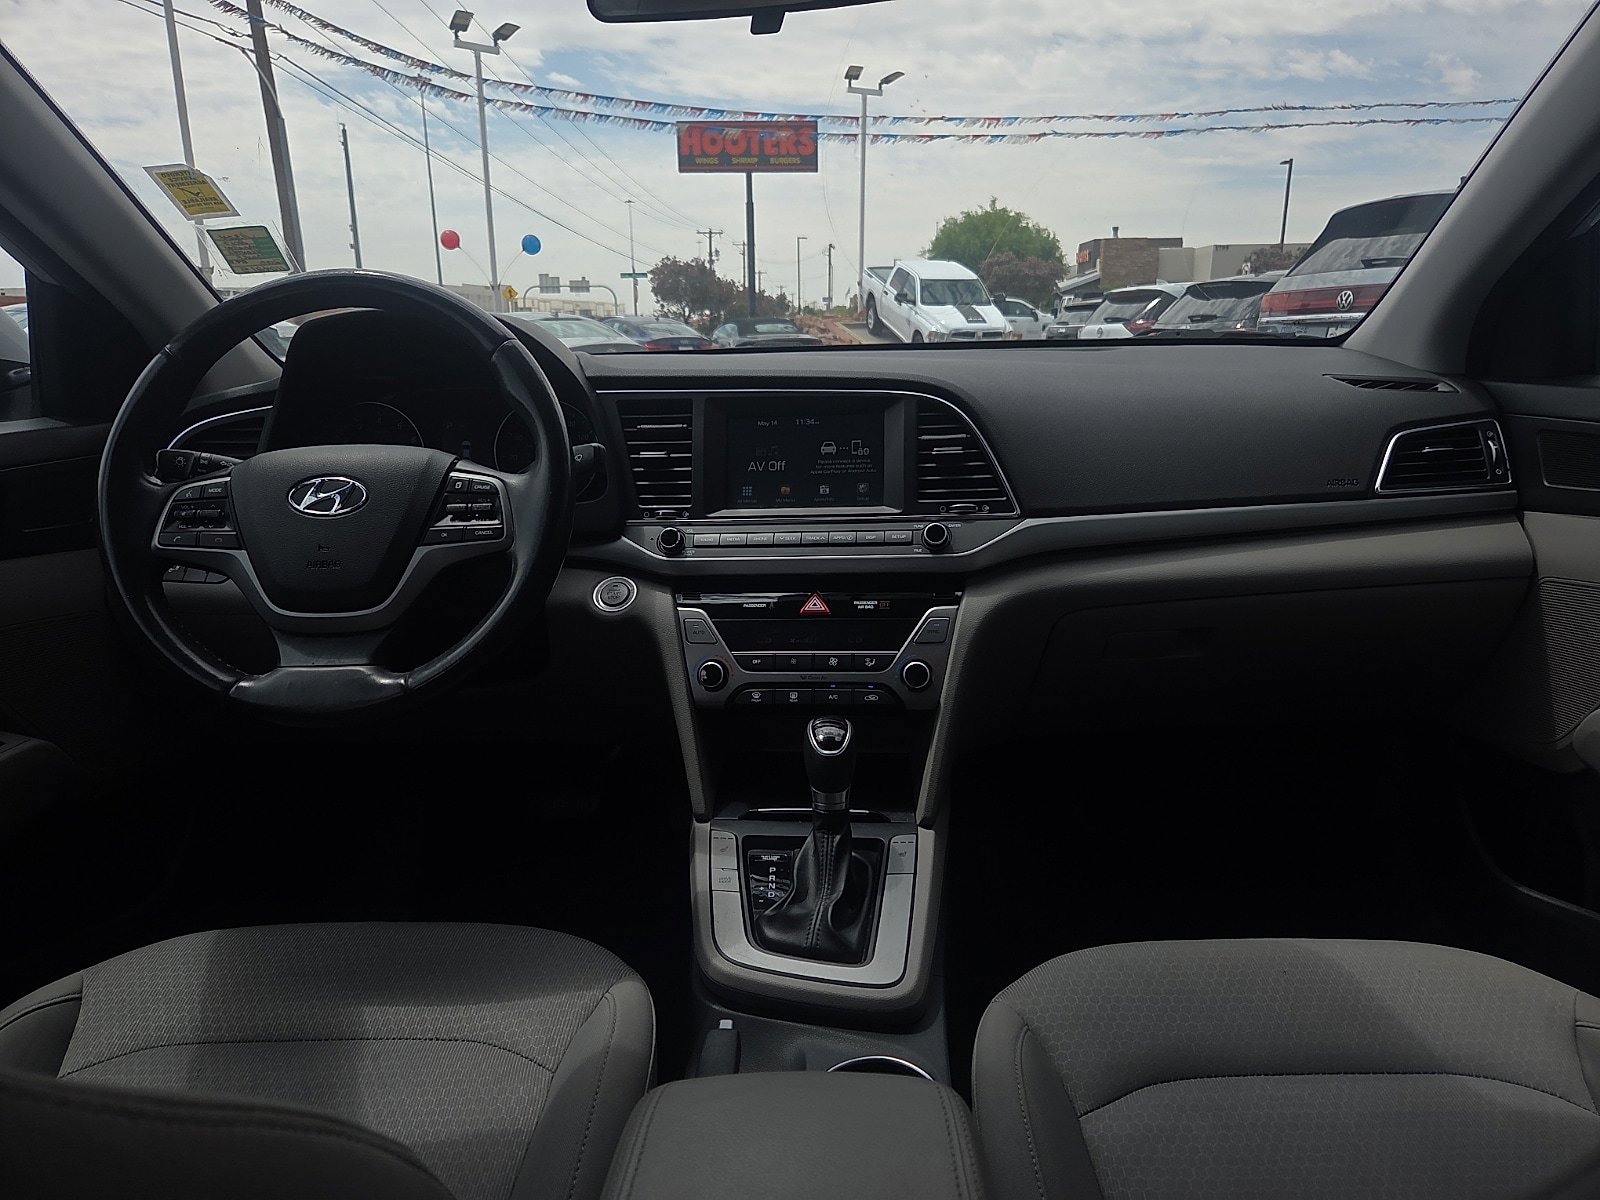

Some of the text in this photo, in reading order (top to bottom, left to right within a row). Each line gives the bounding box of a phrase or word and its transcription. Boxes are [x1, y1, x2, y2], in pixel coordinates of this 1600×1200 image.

[680, 125, 816, 156] HOOTERS
[747, 460, 787, 472] AV Off
[1327, 479, 1360, 487] AIRBAG
[306, 559, 344, 569] AIRBAG
[769, 866, 777, 874] P
